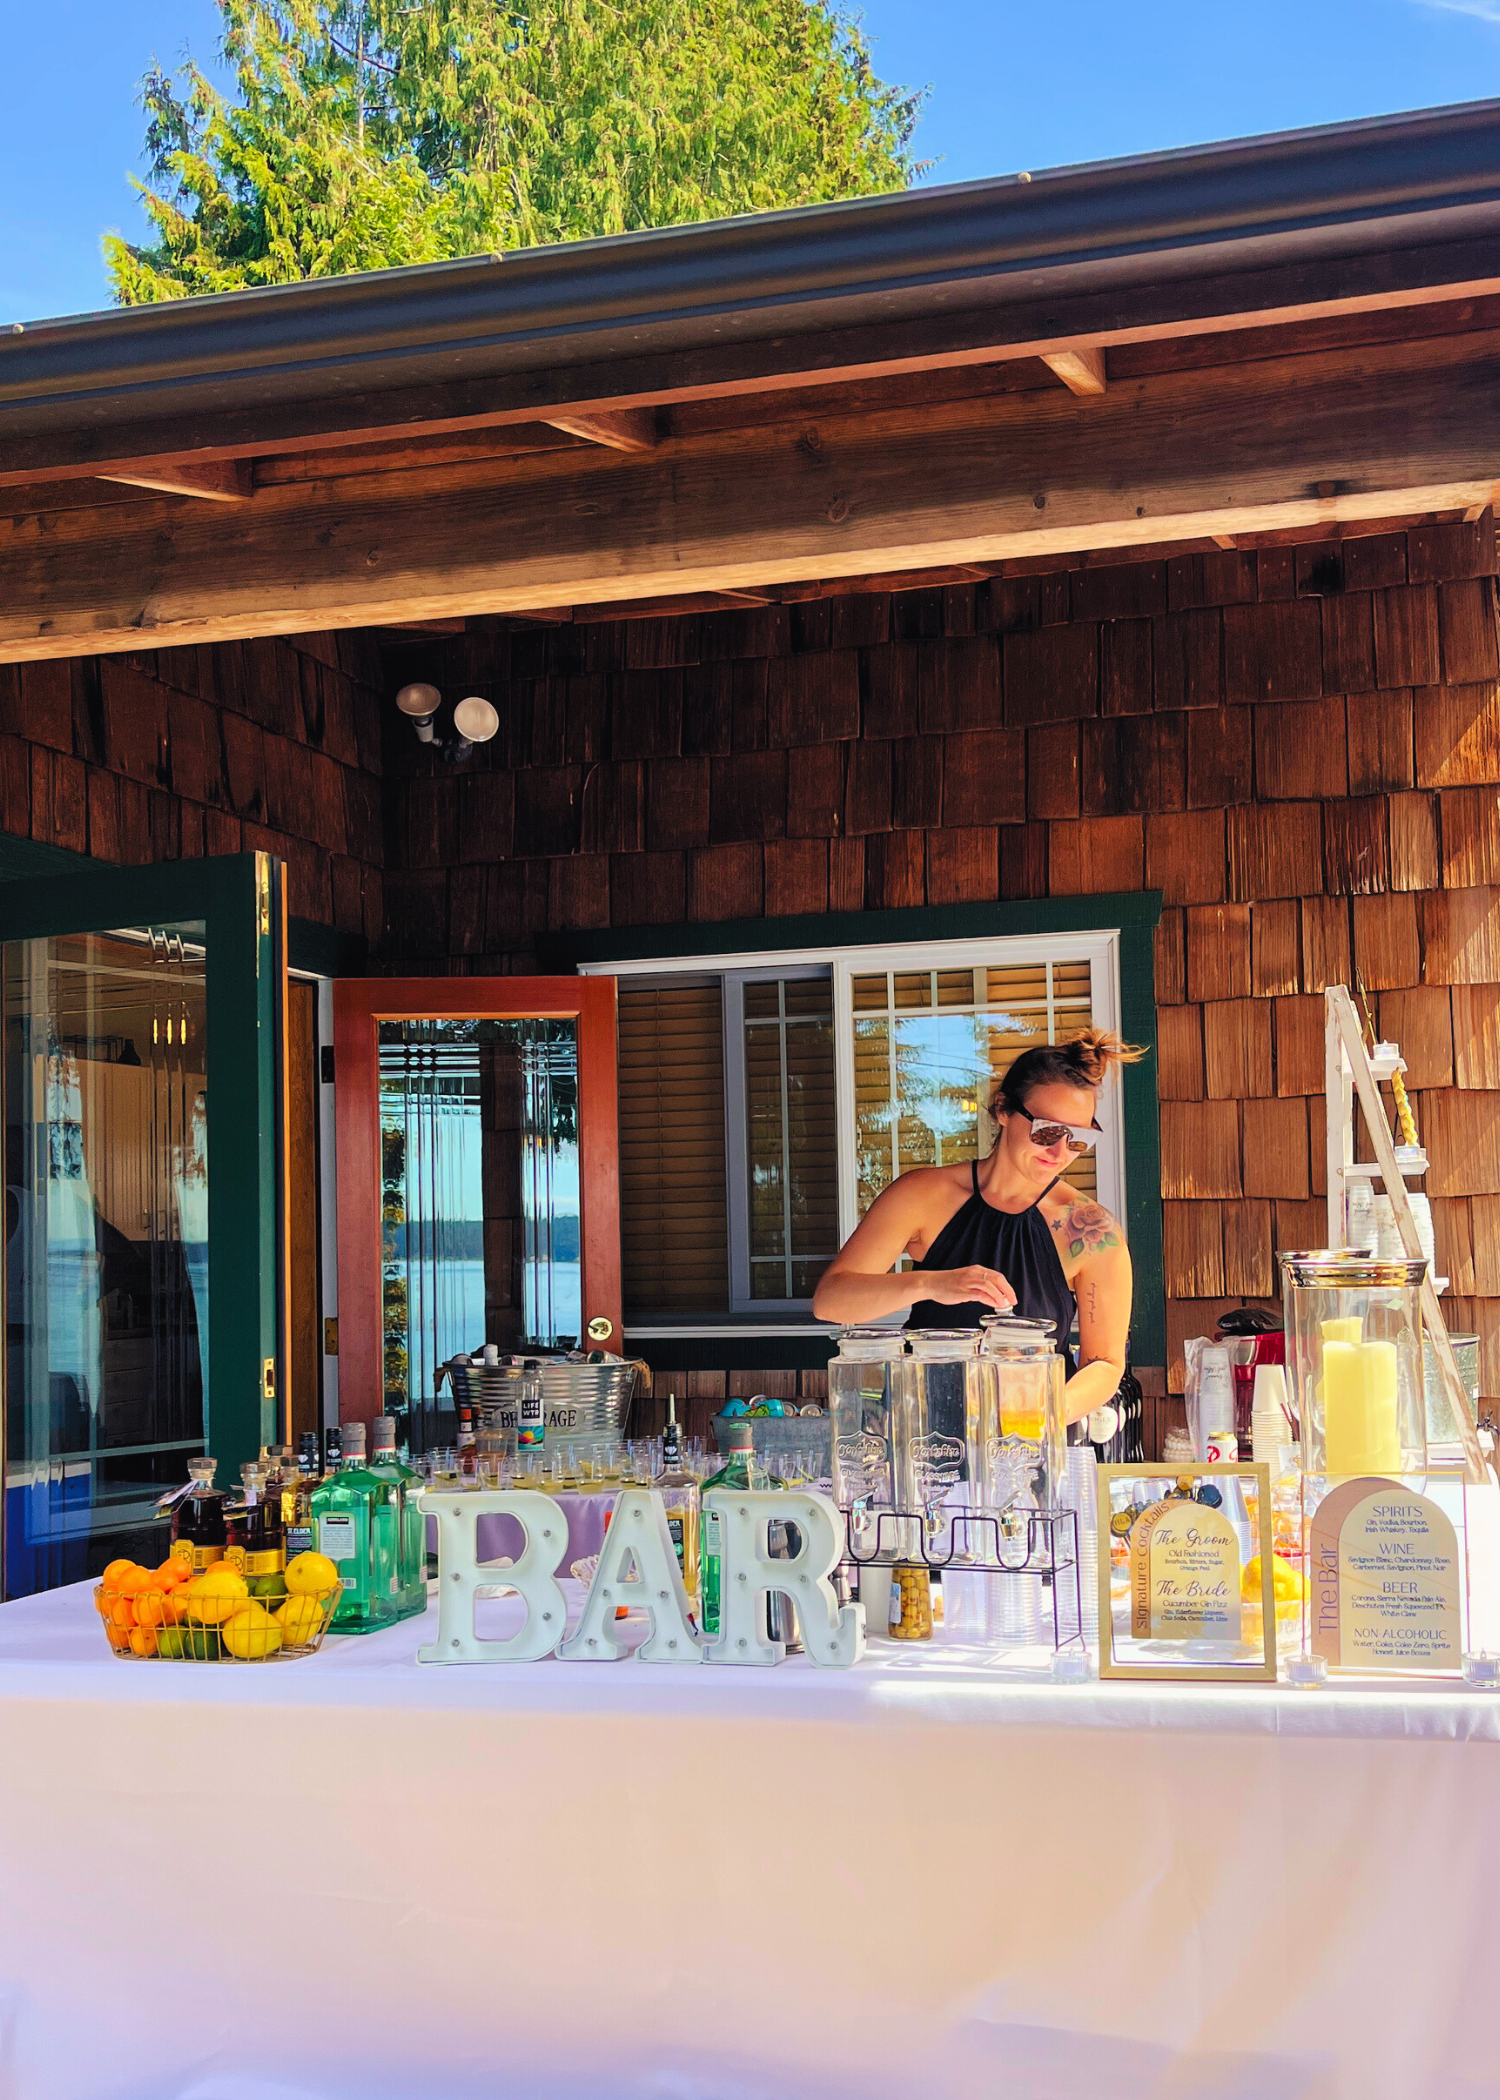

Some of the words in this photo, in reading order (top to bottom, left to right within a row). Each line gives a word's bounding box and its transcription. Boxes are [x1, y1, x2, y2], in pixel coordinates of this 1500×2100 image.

[500, 1410, 577, 1428] BERAGE
[1372, 1505, 1423, 1518] SPIRITS
[1137, 1502, 1170, 1557] Cocktails
[1155, 1529, 1181, 1545] The
[1185, 1528, 1234, 1548] Groom
[1168, 1549, 1182, 1558] Old
[1183, 1549, 1220, 1558] Fashioned
[1379, 1543, 1415, 1555] WINE
[1318, 1543, 1338, 1583] Bar
[416, 1490, 868, 1669] BAR
[1156, 1580, 1183, 1596] The
[1185, 1579, 1232, 1597] Bride
[1382, 1581, 1418, 1594] BEER
[1136, 1562, 1150, 1629] Signature
[1162, 1599, 1199, 1608] Cucumber
[1199, 1599, 1212, 1608] Gin
[1212, 1600, 1228, 1608] Fizz
[1319, 1589, 1338, 1635] The
[1354, 1628, 1448, 1640] NON-ALCOHOLIC
